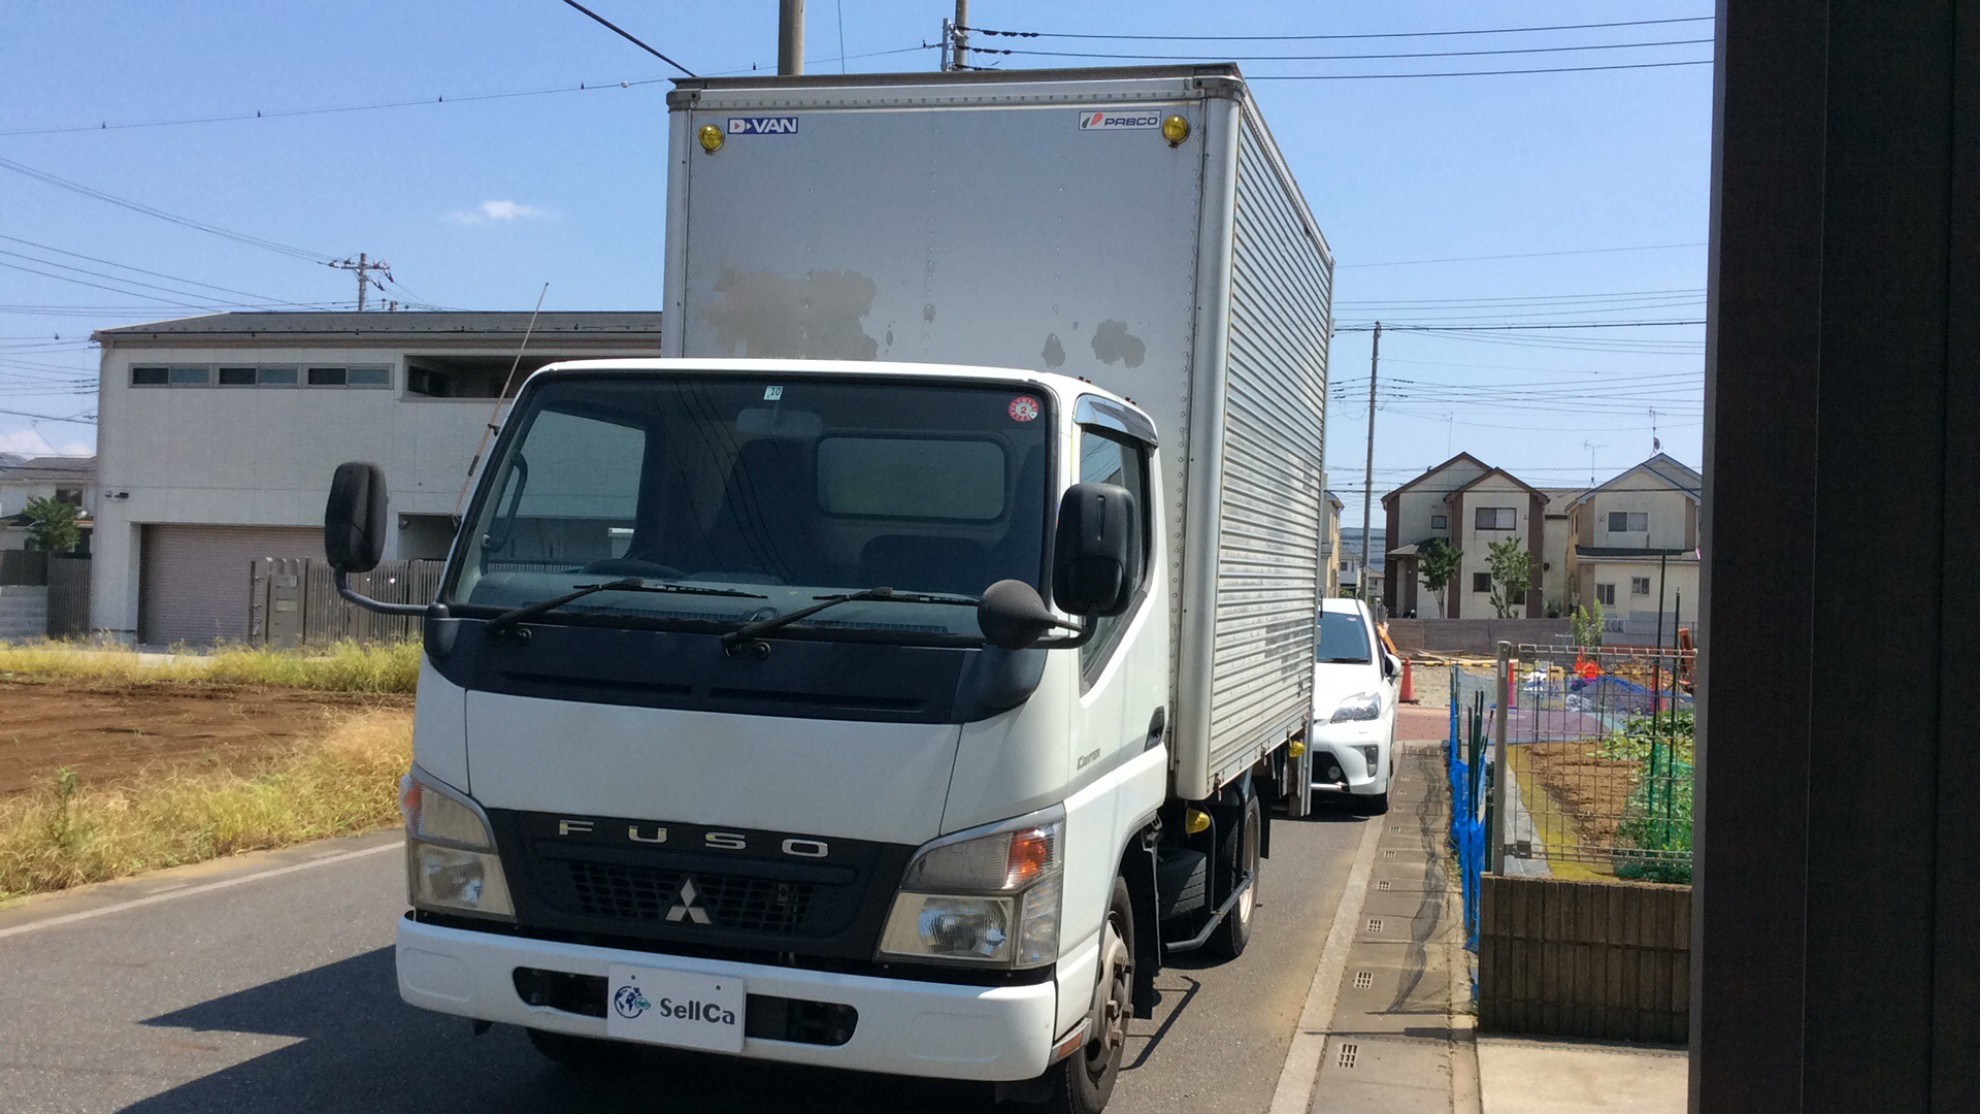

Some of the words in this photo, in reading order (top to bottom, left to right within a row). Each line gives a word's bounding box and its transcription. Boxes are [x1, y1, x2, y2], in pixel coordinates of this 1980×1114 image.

[1104, 117, 1158, 126] PABCO
[559, 819, 828, 857] FUSO
[660, 998, 735, 1025] SellCa
